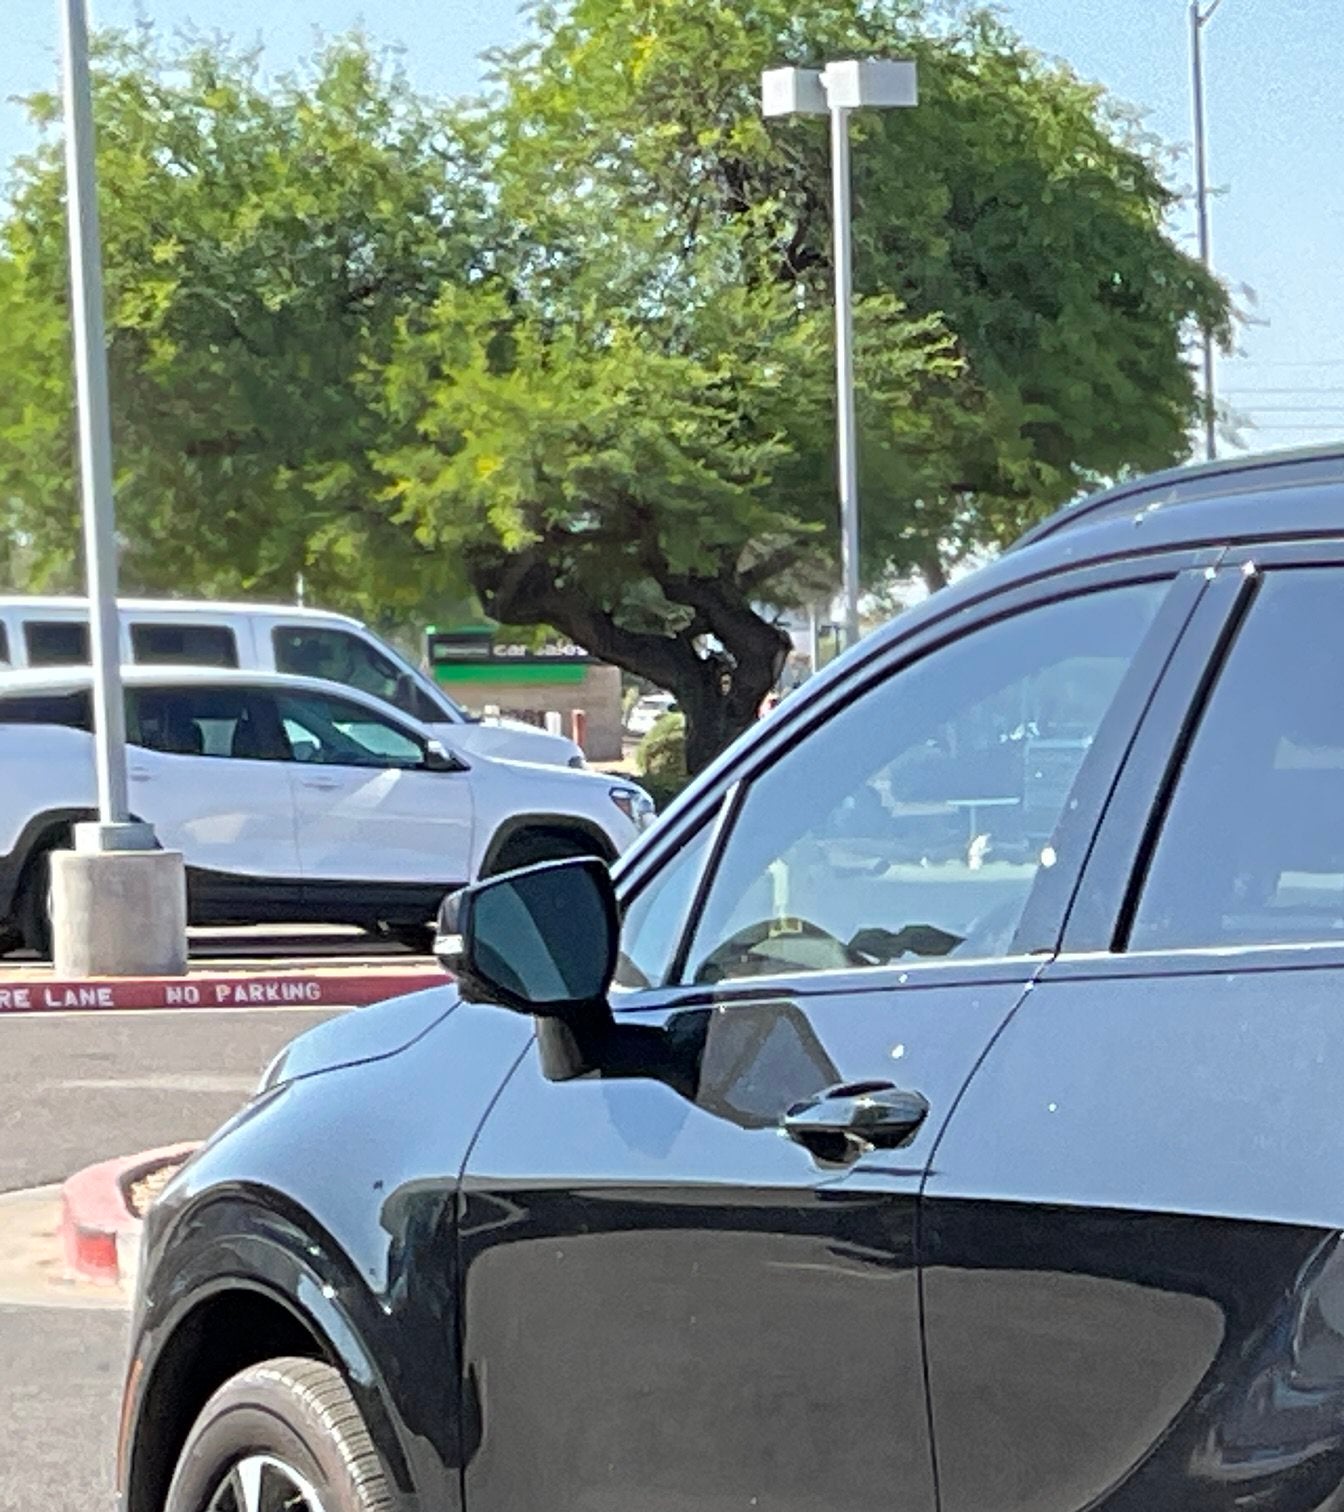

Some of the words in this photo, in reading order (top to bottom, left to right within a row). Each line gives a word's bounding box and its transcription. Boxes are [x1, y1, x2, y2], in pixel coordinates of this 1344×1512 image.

[46, 988, 114, 1008] LANE
[165, 986, 199, 1005] NO
[216, 983, 321, 1002] PARKING
